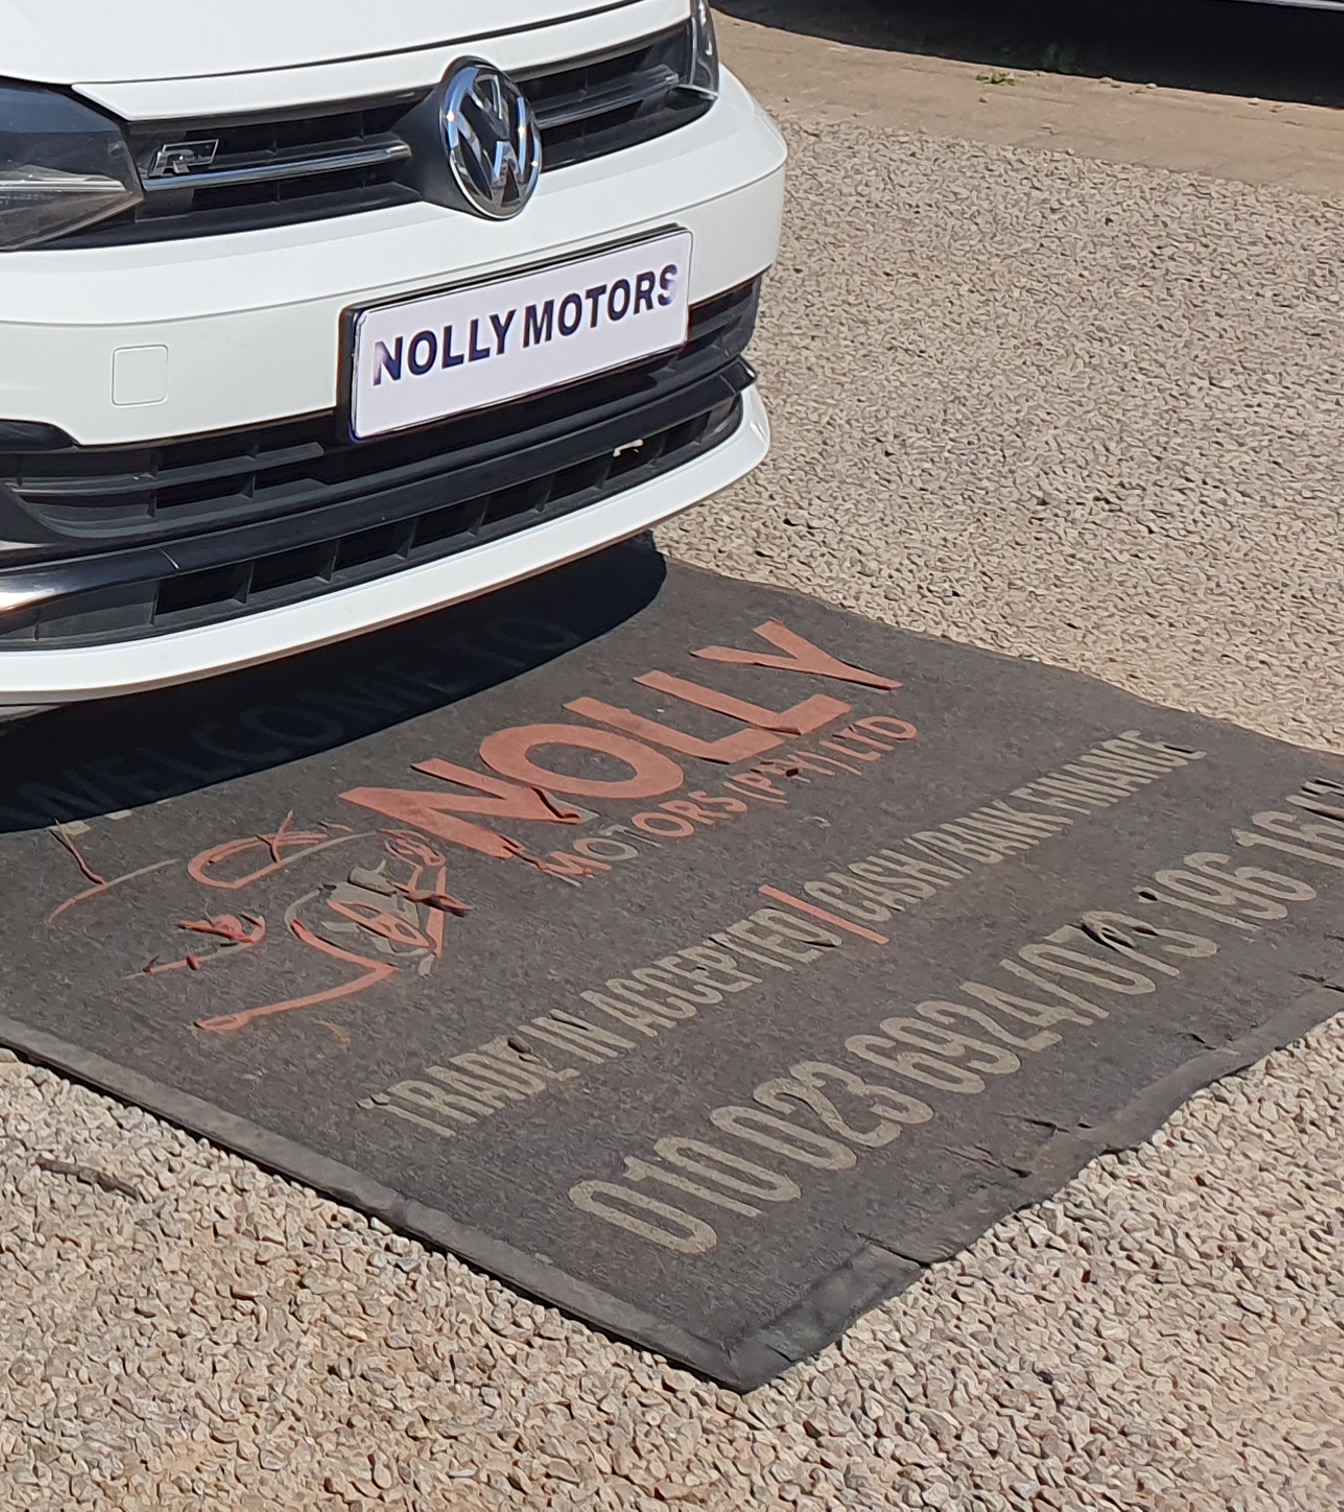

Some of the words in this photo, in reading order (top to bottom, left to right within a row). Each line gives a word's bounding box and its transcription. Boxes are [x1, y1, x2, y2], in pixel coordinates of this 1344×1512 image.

[372, 307, 518, 387] NOLLY
[522, 262, 680, 349] MOTORS
[338, 617, 904, 859] NOLLY
[534, 791, 749, 887] MOTORS
[356, 1034, 581, 1138] TRADE
[517, 1008, 636, 1064] IN
[1011, 729, 1208, 816] FINANCE
[568, 1135, 802, 1255] 010
[710, 1060, 935, 1171] 023
[1132, 851, 1318, 932] 196
